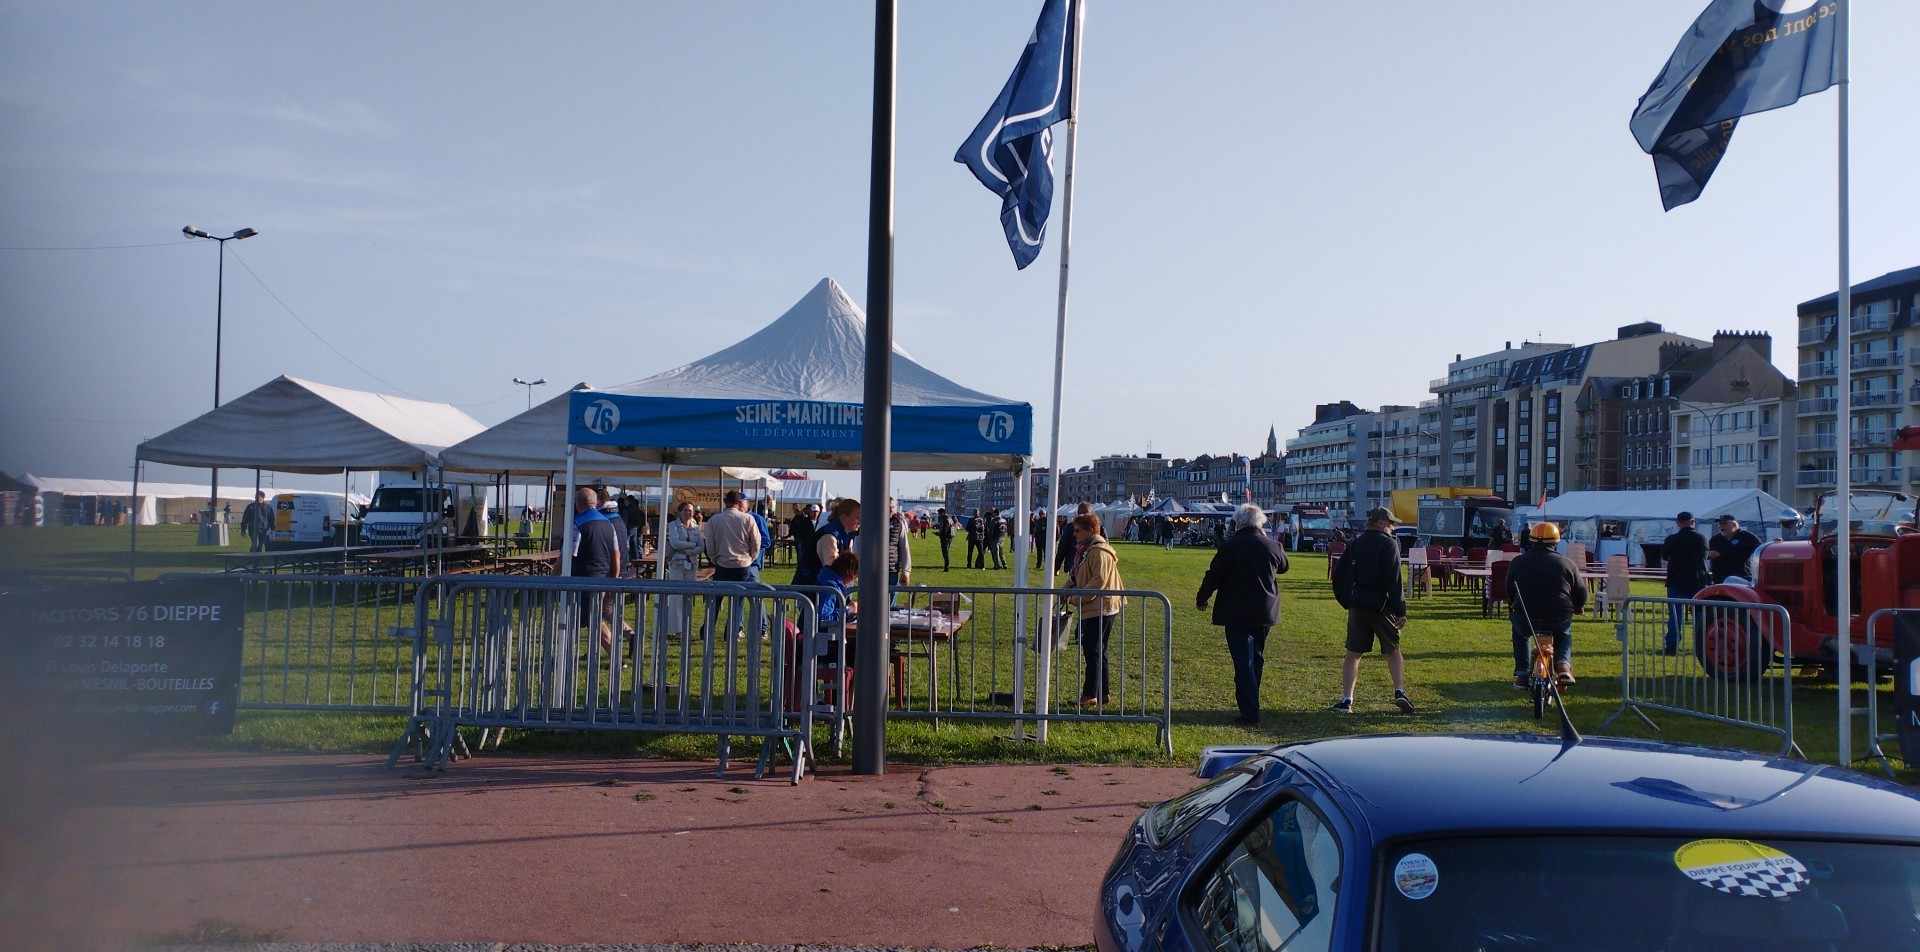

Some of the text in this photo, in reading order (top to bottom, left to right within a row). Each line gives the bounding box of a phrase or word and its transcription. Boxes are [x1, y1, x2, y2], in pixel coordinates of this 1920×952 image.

[736, 401, 864, 425] SEINE-MARITIME
[126, 605, 148, 621] 76
[154, 605, 222, 622] DIEPPE
[126, 635, 142, 648] 18
[149, 635, 165, 648] 18
